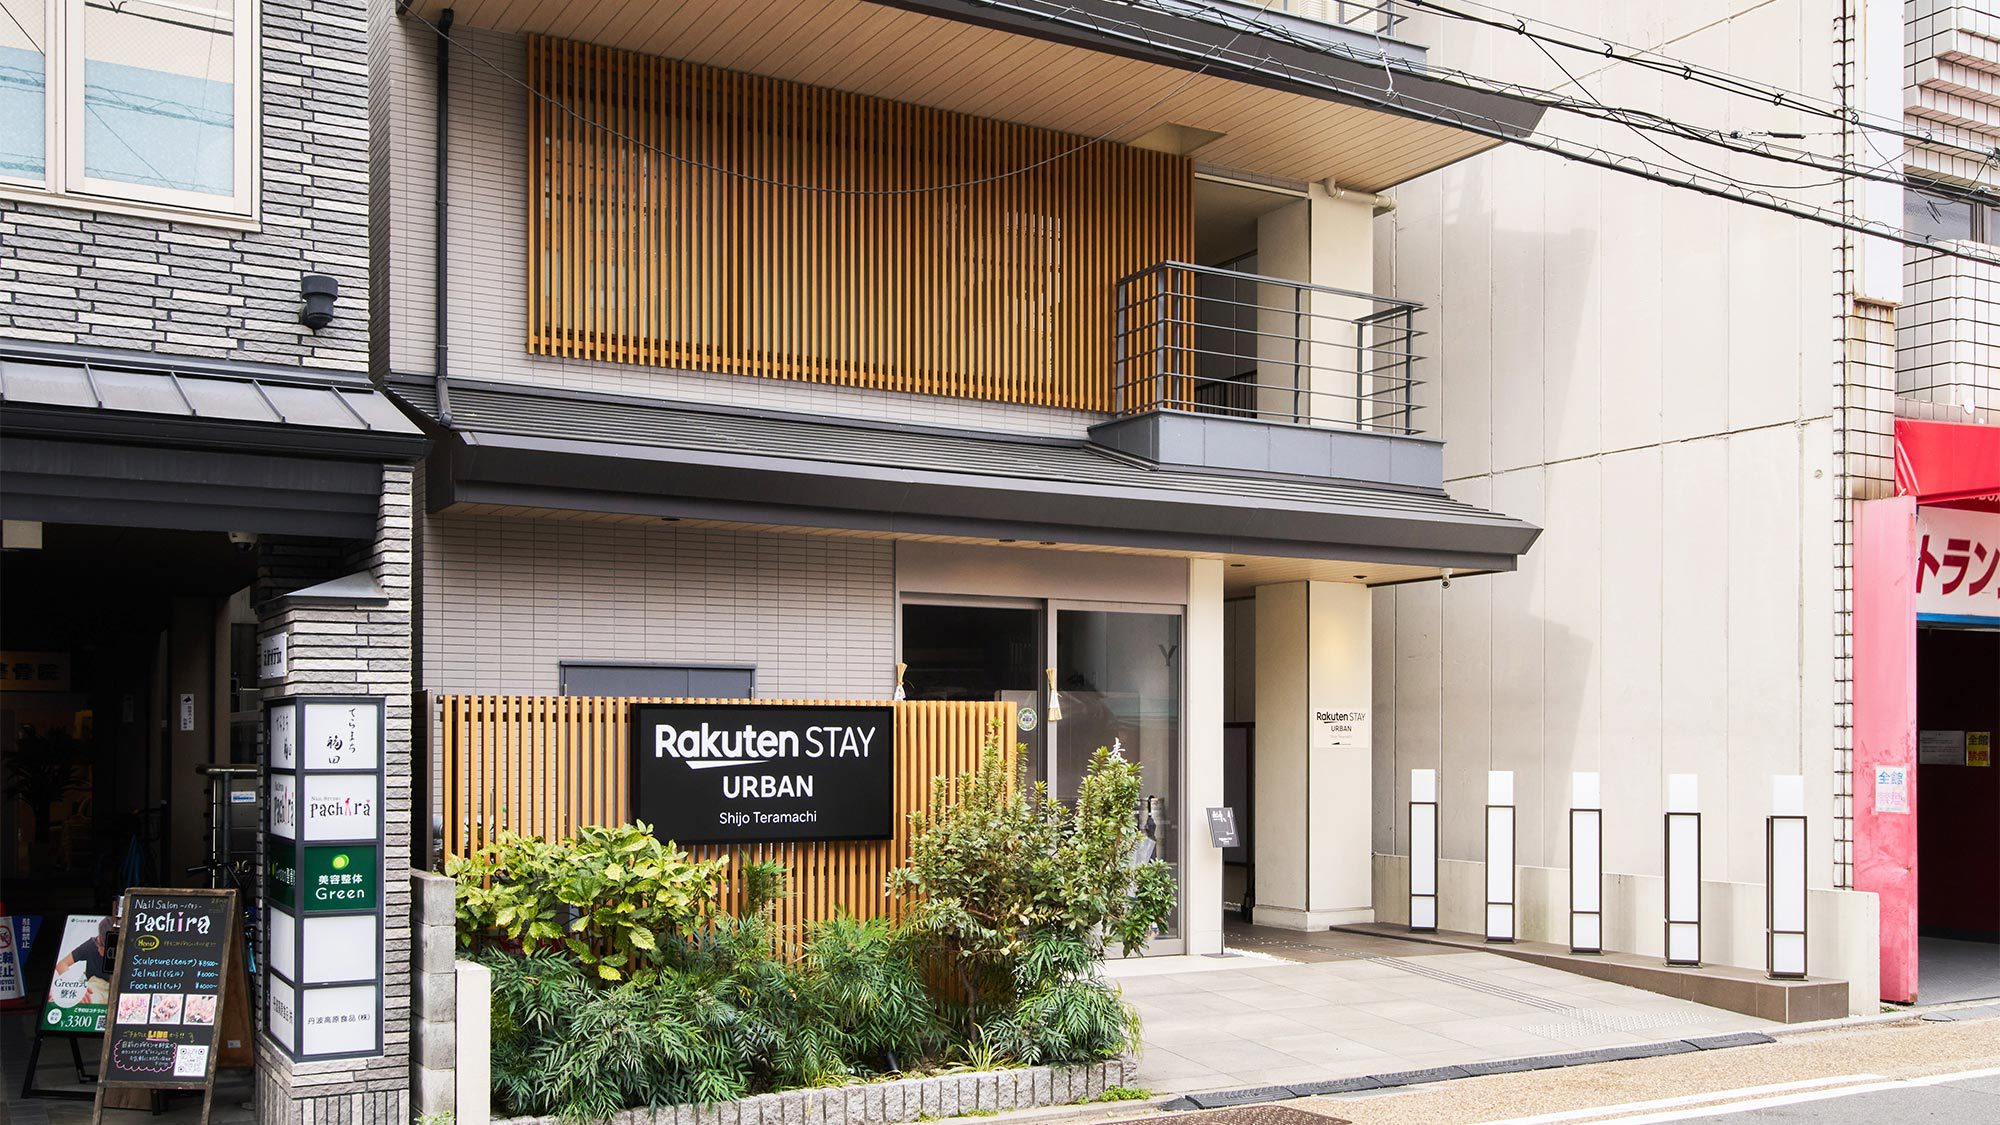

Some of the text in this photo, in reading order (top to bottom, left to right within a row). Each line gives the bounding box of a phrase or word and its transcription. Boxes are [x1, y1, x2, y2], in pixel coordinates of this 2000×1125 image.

[1916, 534, 2000, 599] トラン
[1316, 711, 1366, 721] Rakuten STAY
[655, 722, 876, 758] Rakuten STAY
[723, 775, 814, 799] URBAN
[719, 810, 817, 827] Shijo Teramachi
[318, 873, 363, 885] 美容整体
[315, 887, 365, 900] Green
[134, 899, 155, 910] Nail
[155, 899, 179, 910] Salon
[135, 911, 211, 934] Pachira
[0, 965, 14, 977] 止
